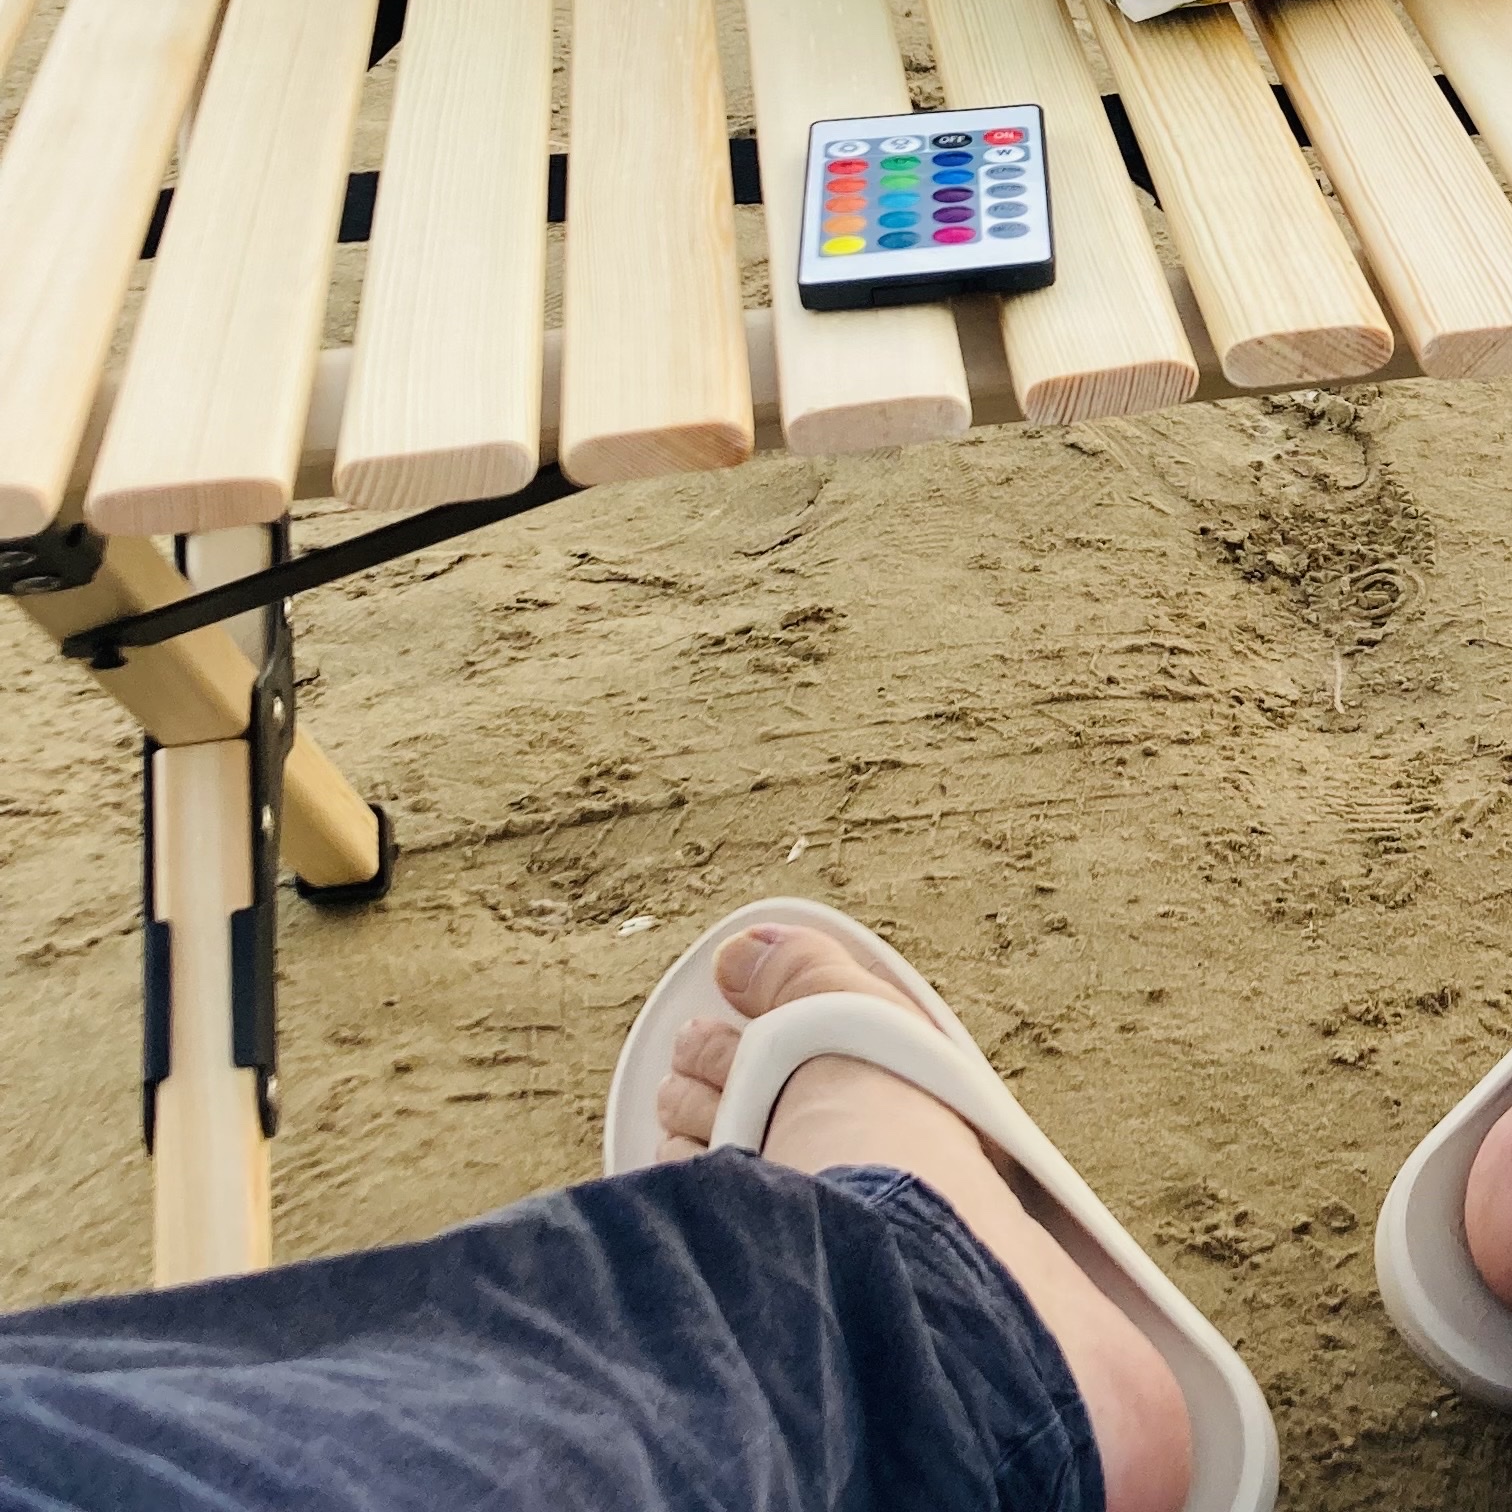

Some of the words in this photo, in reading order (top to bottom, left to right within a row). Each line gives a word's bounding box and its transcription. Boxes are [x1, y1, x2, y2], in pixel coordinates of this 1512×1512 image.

[938, 135, 966, 144] OFF
[993, 131, 1015, 139] ON
[996, 148, 1013, 156] W
